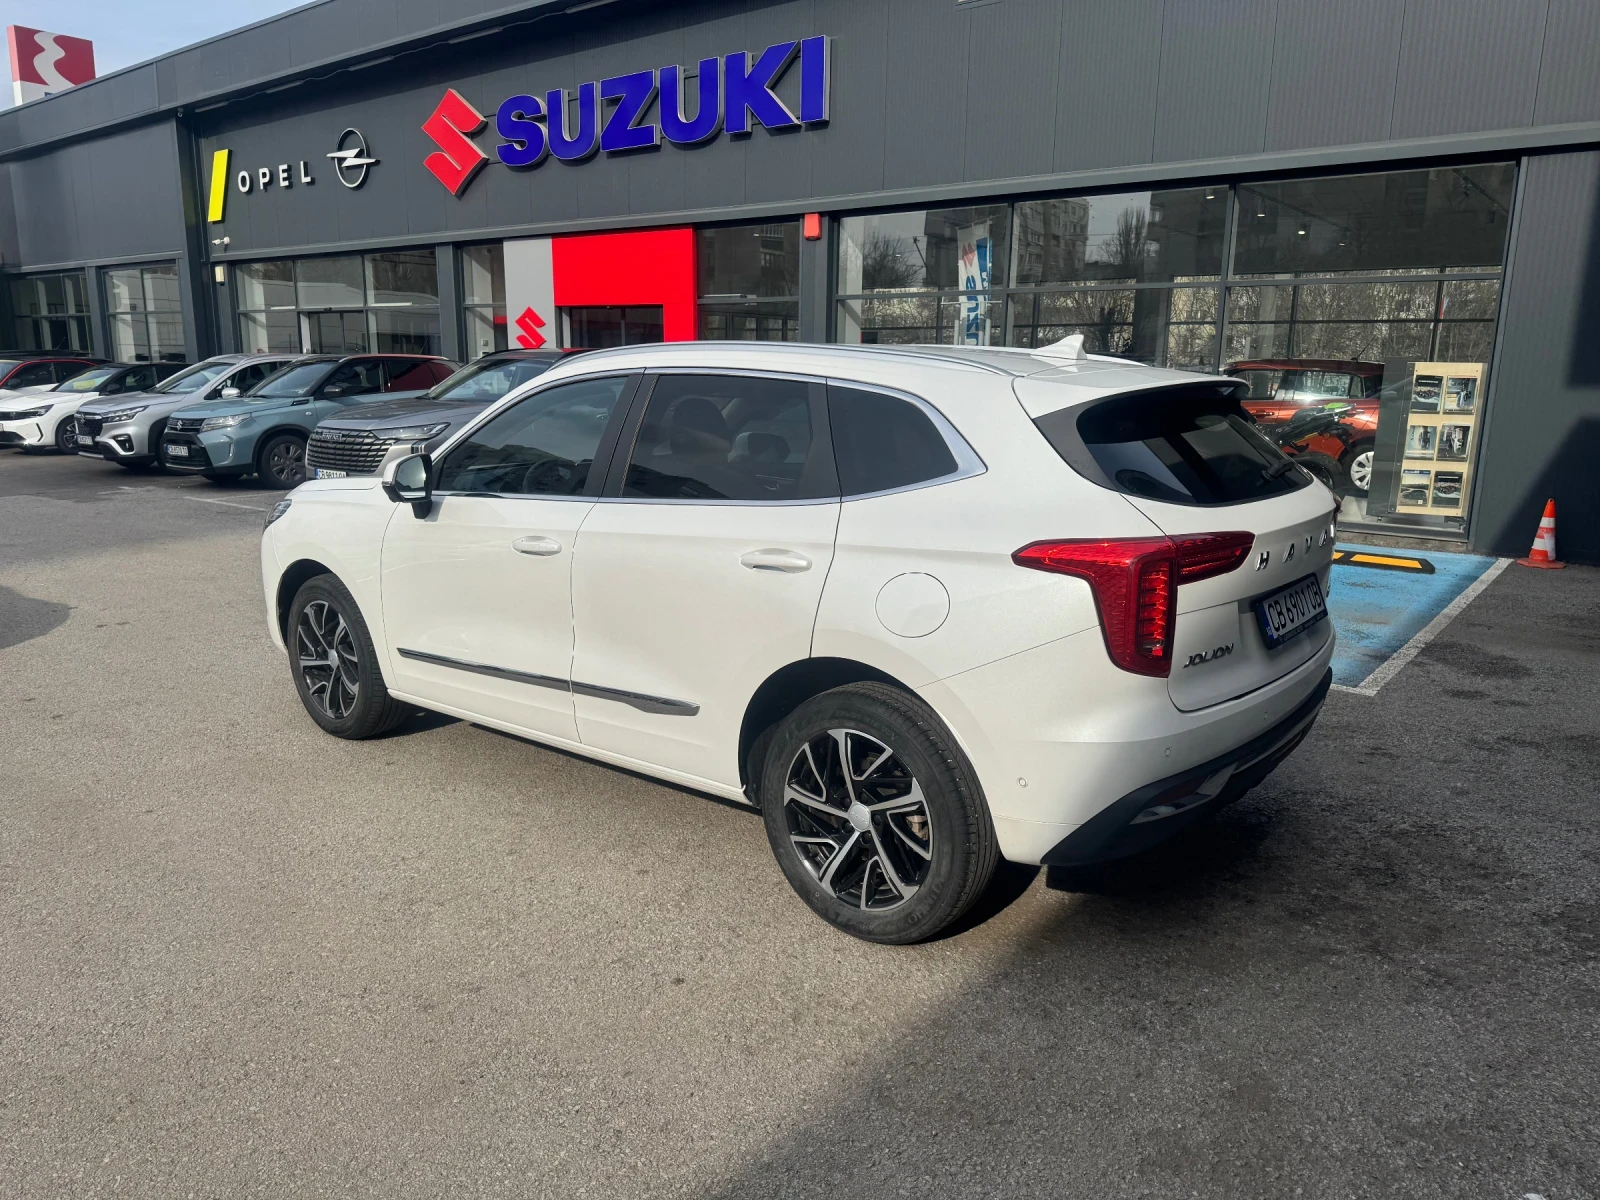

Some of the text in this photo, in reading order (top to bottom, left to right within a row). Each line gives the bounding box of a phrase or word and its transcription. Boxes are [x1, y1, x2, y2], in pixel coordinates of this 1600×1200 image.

[496, 35, 829, 166] SUZUKI
[238, 161, 312, 193] OPEL
[1267, 600, 1286, 632] CB
[1284, 591, 1311, 624] 6901
[1183, 643, 1234, 669] JOLION
